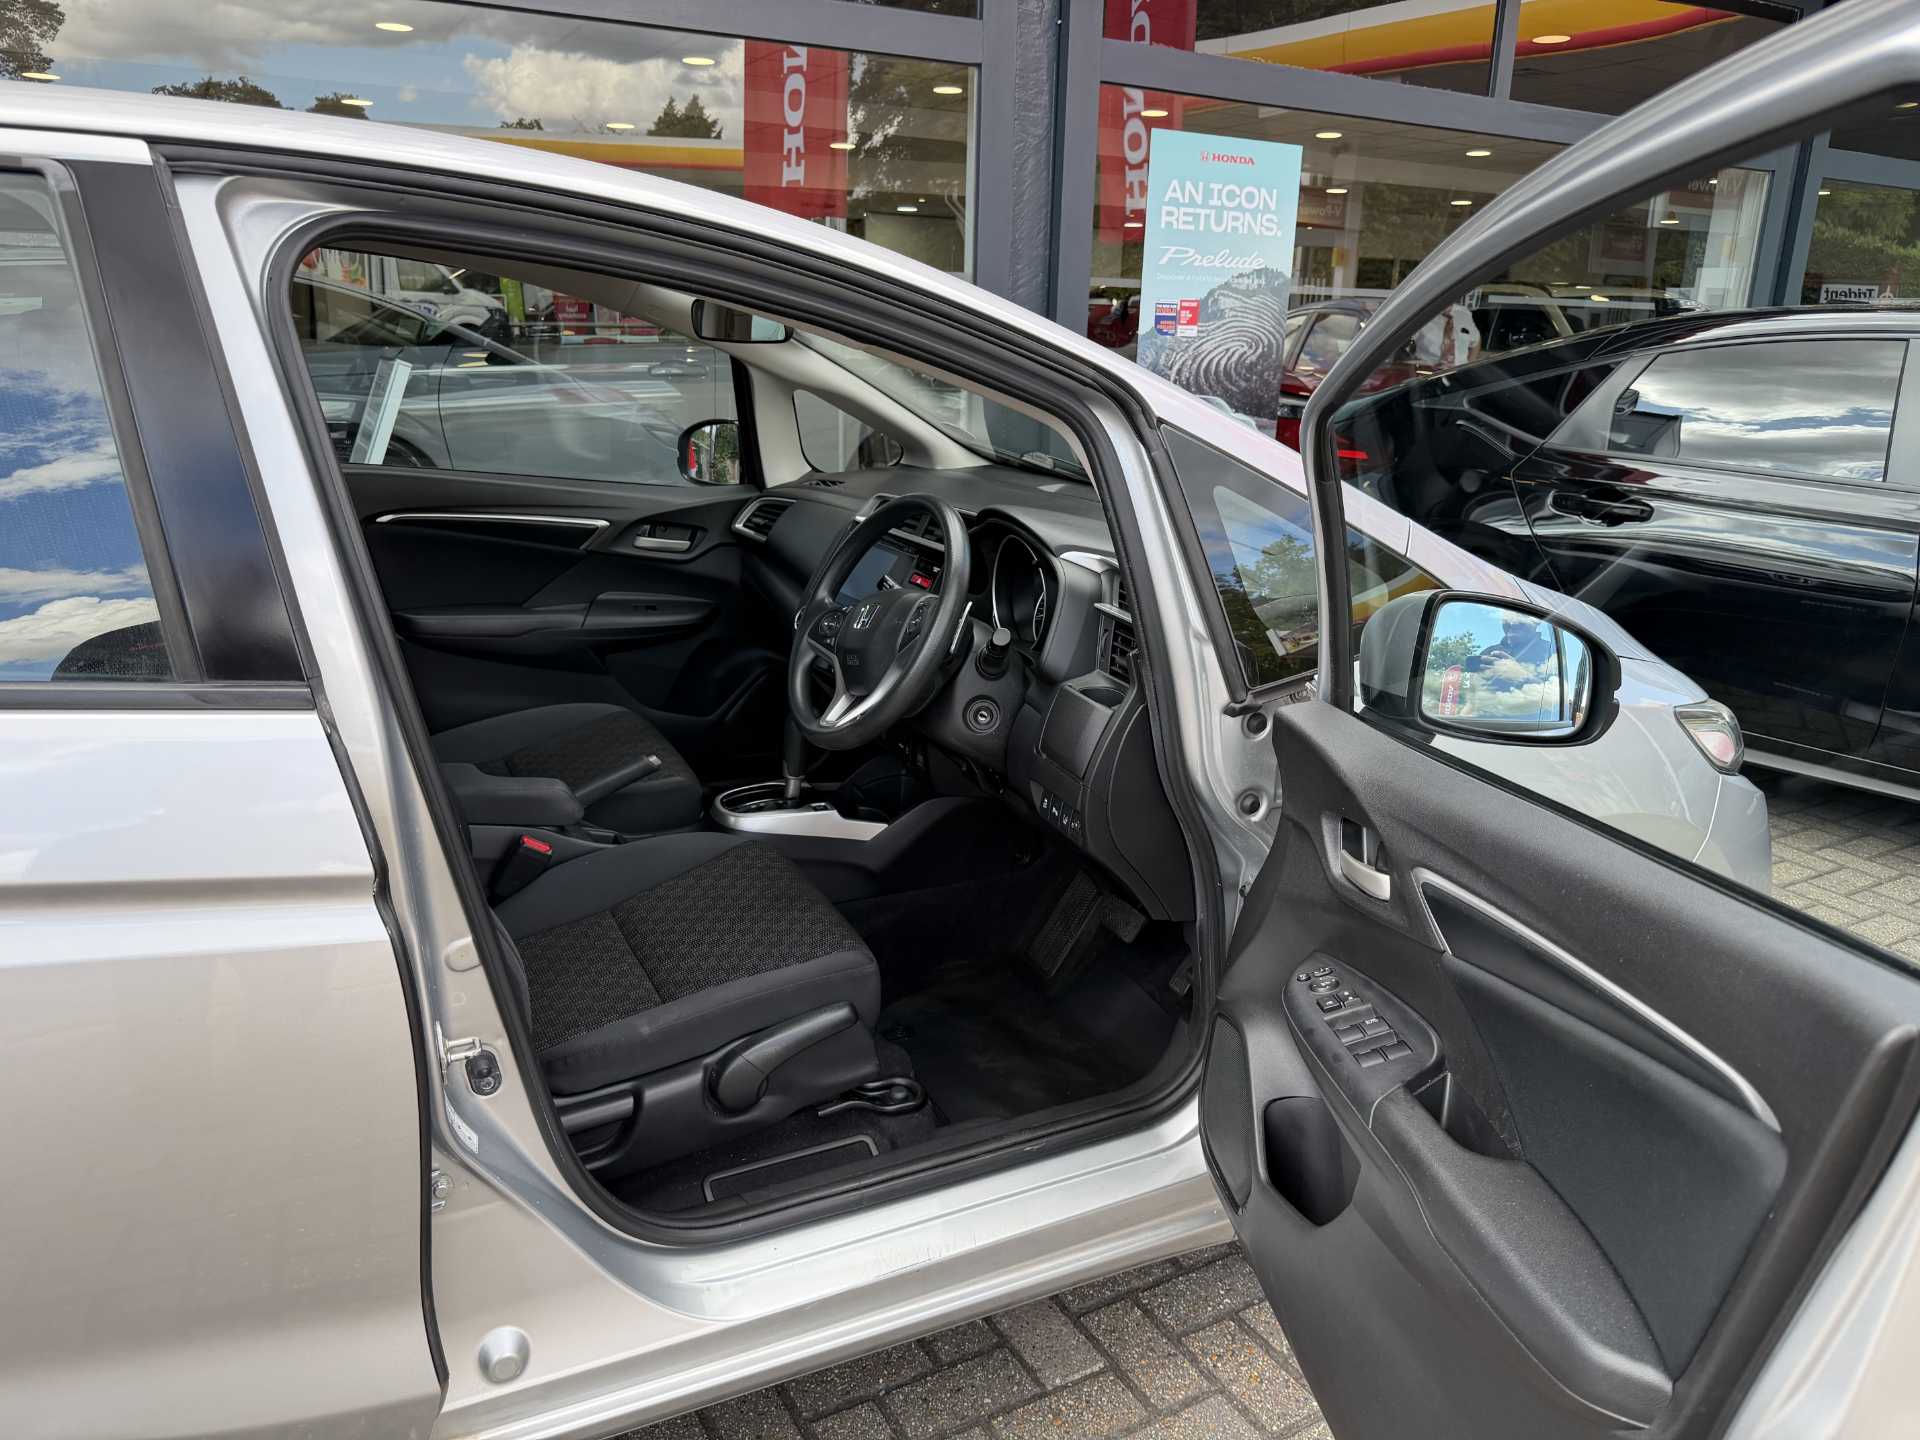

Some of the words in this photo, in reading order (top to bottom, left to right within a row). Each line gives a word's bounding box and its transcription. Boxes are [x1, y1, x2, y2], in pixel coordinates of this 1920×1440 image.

[1211, 152, 1256, 166] HONDA
[1164, 179, 1204, 205] AN
[1208, 182, 1277, 210] ICON
[1160, 205, 1282, 237] RETURNS.
[1158, 246, 1265, 269] Prelude
